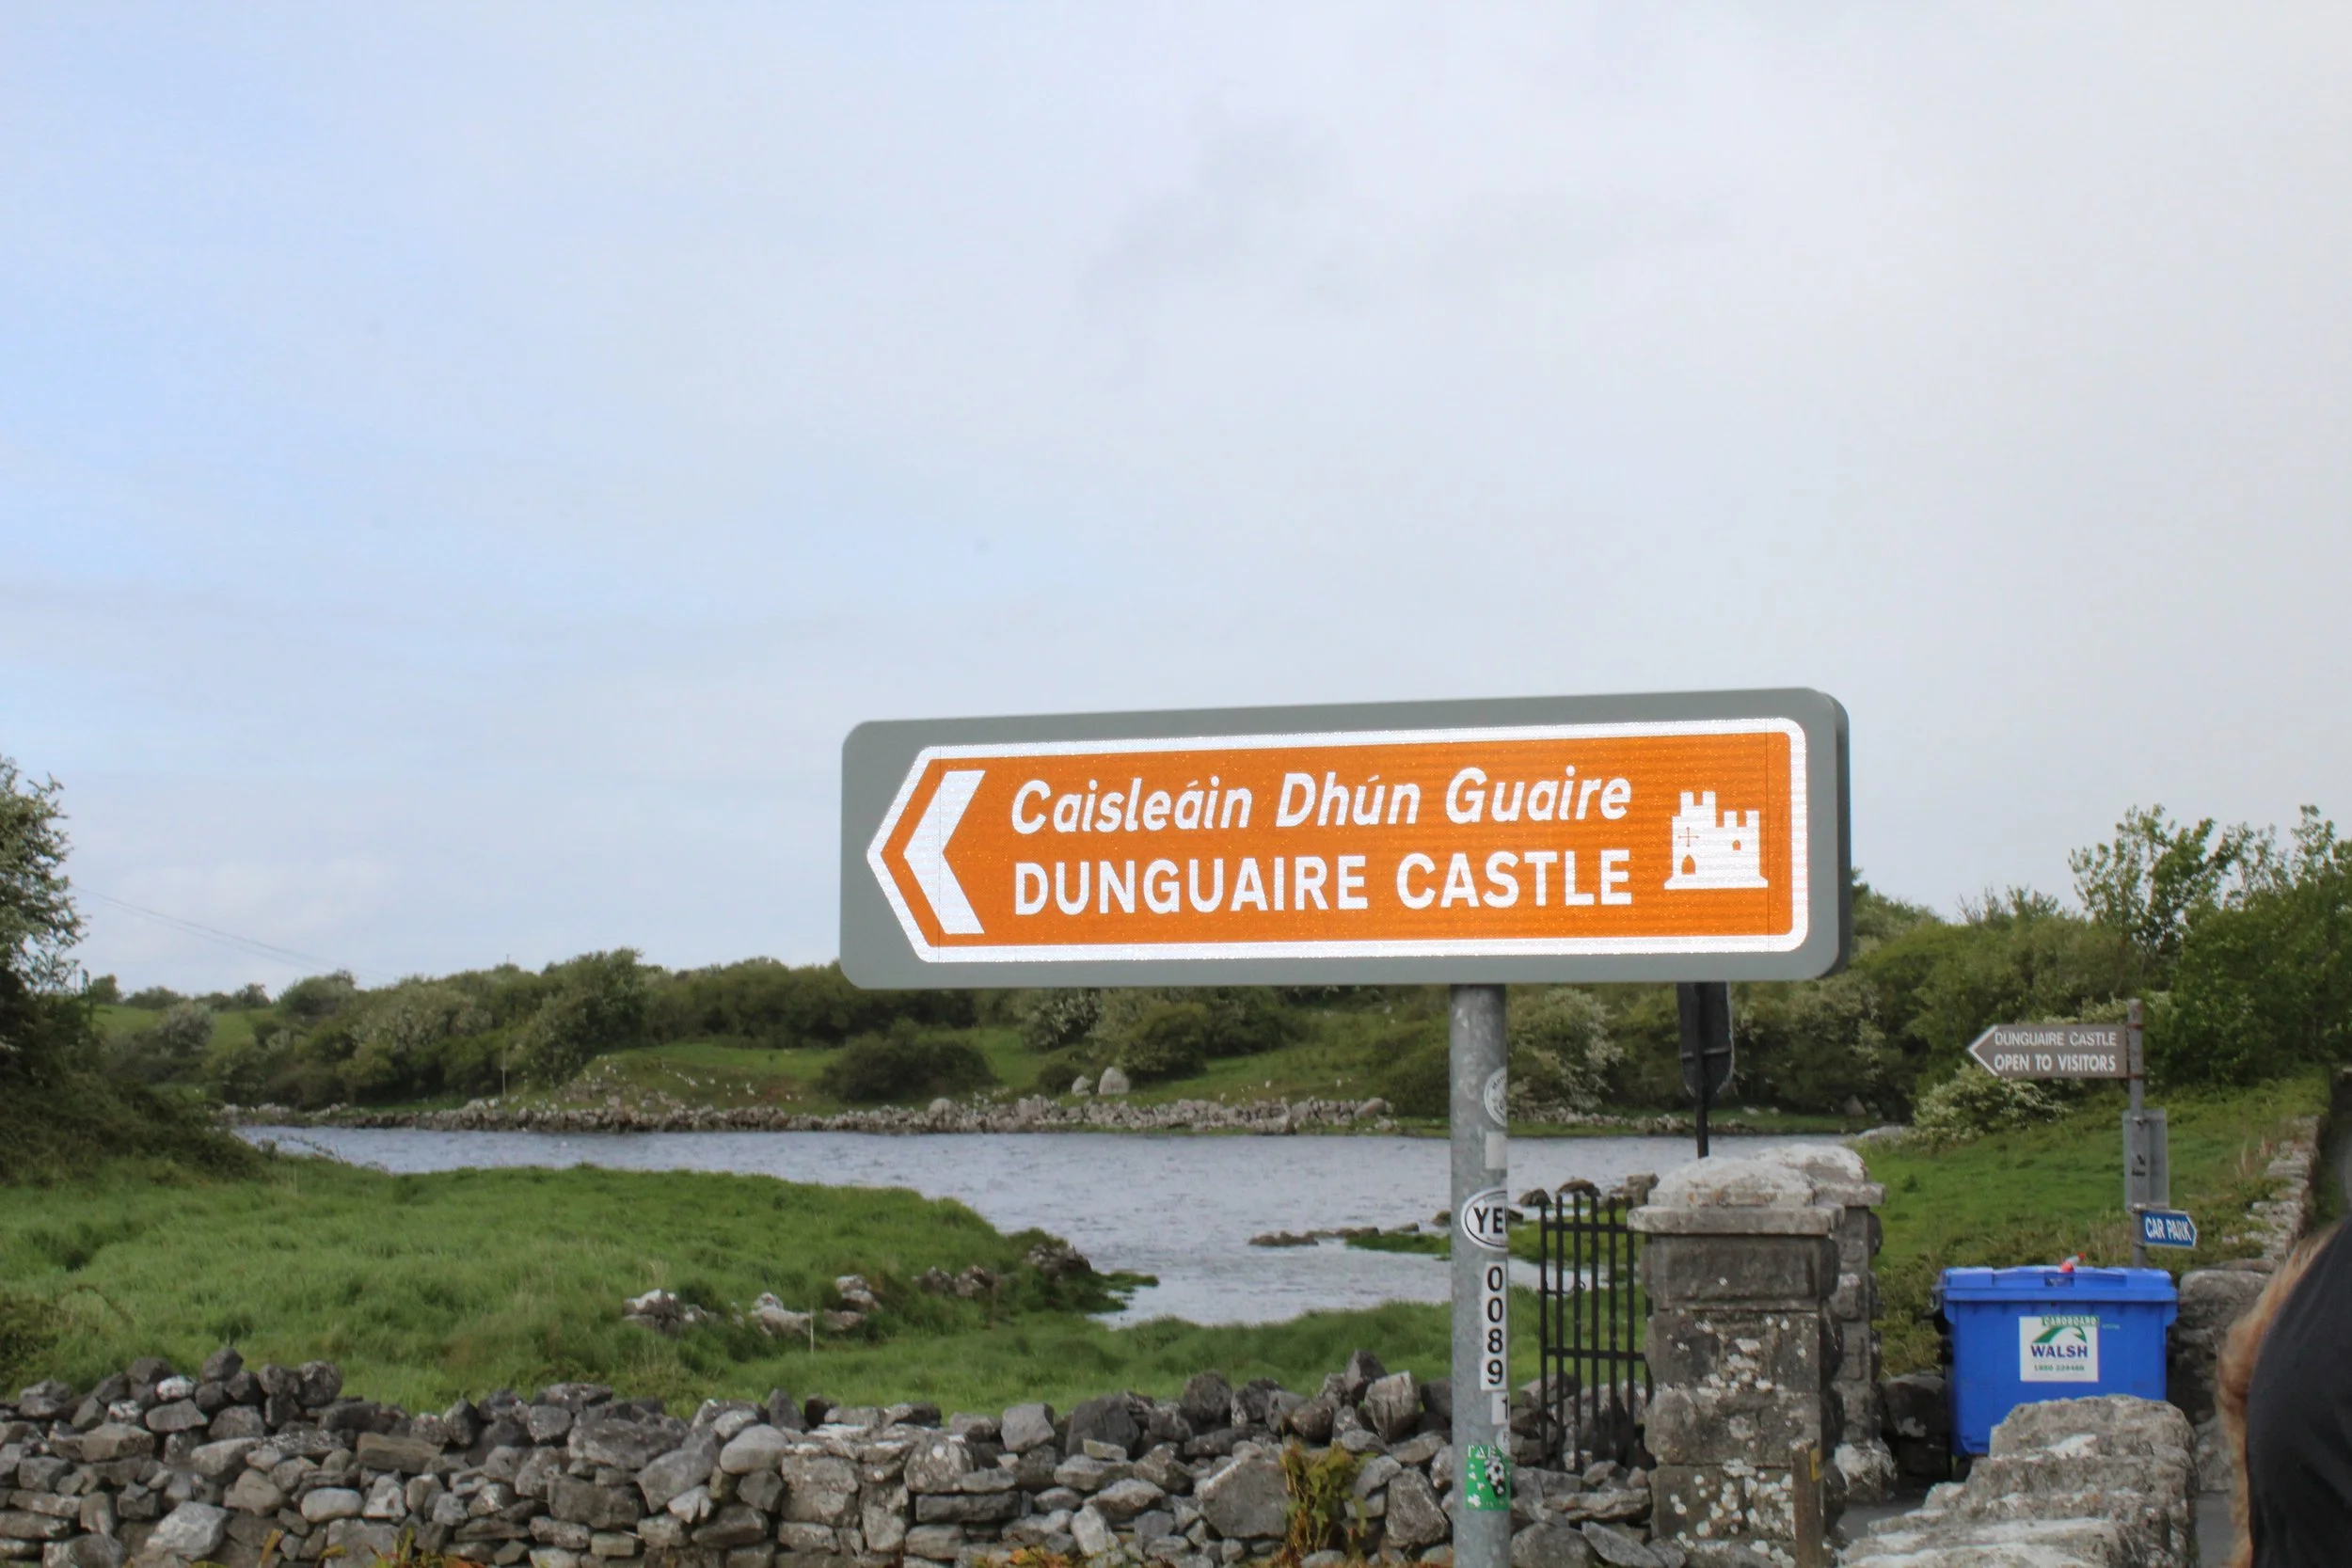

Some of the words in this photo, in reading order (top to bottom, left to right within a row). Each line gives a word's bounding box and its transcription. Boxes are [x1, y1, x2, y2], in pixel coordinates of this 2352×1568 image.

[1010, 774, 1253, 835] Caisleáin
[1276, 771, 1422, 828] Dhún
[1445, 765, 1632, 825] Guaire
[1014, 854, 1369, 916] DUNGUAIRE
[1396, 849, 1633, 909] CASTLE
[1994, 1031, 2064, 1047] DUNGUAIRE
[2069, 1031, 2117, 1047] CASTLE
[1994, 1053, 2030, 1072] OPEN
[2035, 1053, 2053, 1071] TO
[2058, 1053, 2117, 1072] VISITORS
[1473, 1207, 1508, 1234] YE
[2144, 1216, 2164, 1239] CAR
[2167, 1219, 2192, 1242] PARK
[2030, 1344, 2088, 1358] WALSH
